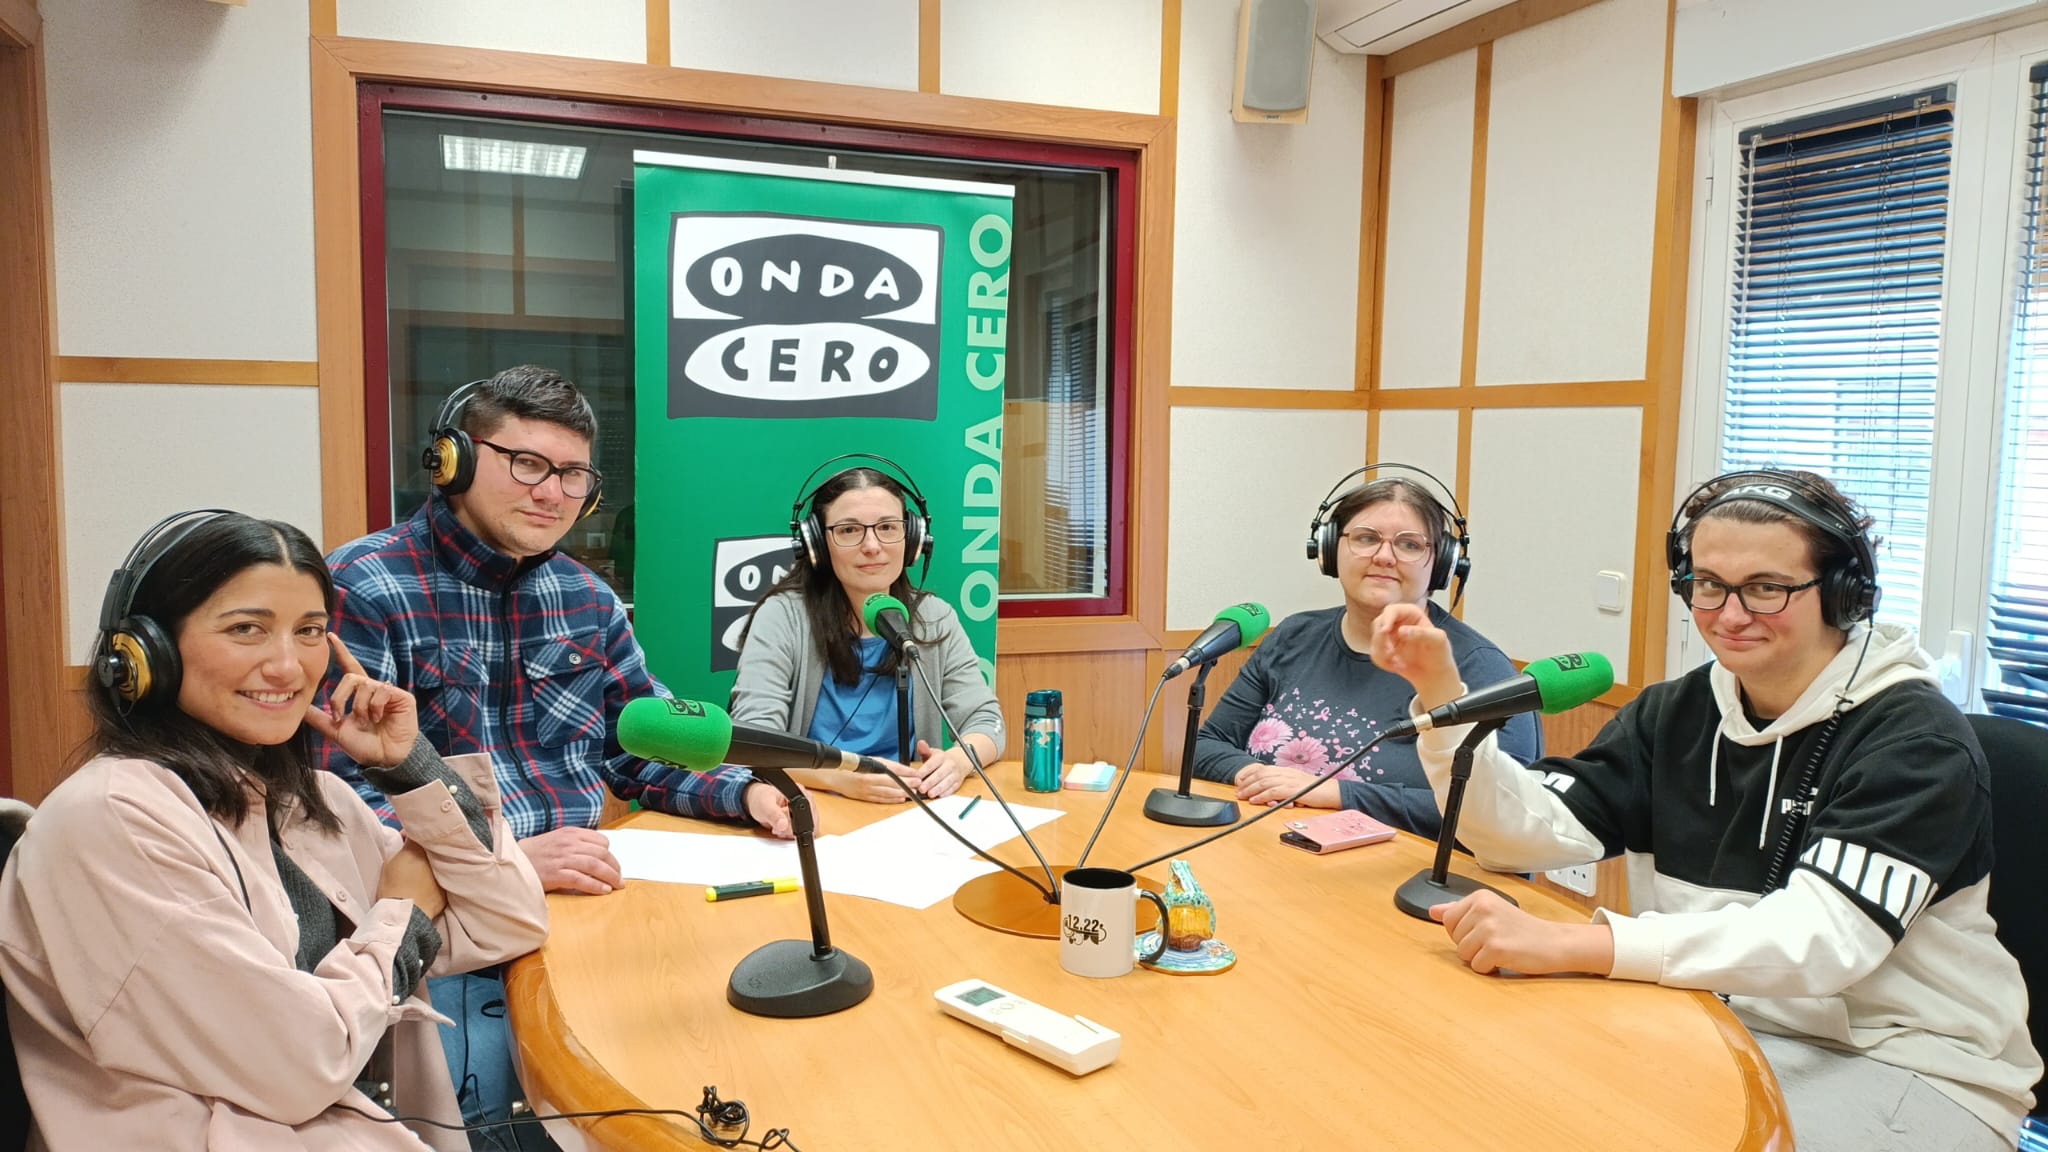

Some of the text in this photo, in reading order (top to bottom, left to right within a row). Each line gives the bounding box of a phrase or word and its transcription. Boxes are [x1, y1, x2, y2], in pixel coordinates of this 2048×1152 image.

[709, 256, 900, 302] ONDA
[965, 213, 1012, 391] CERO
[721, 336, 899, 383] CERO
[960, 413, 1004, 622] ONDA
